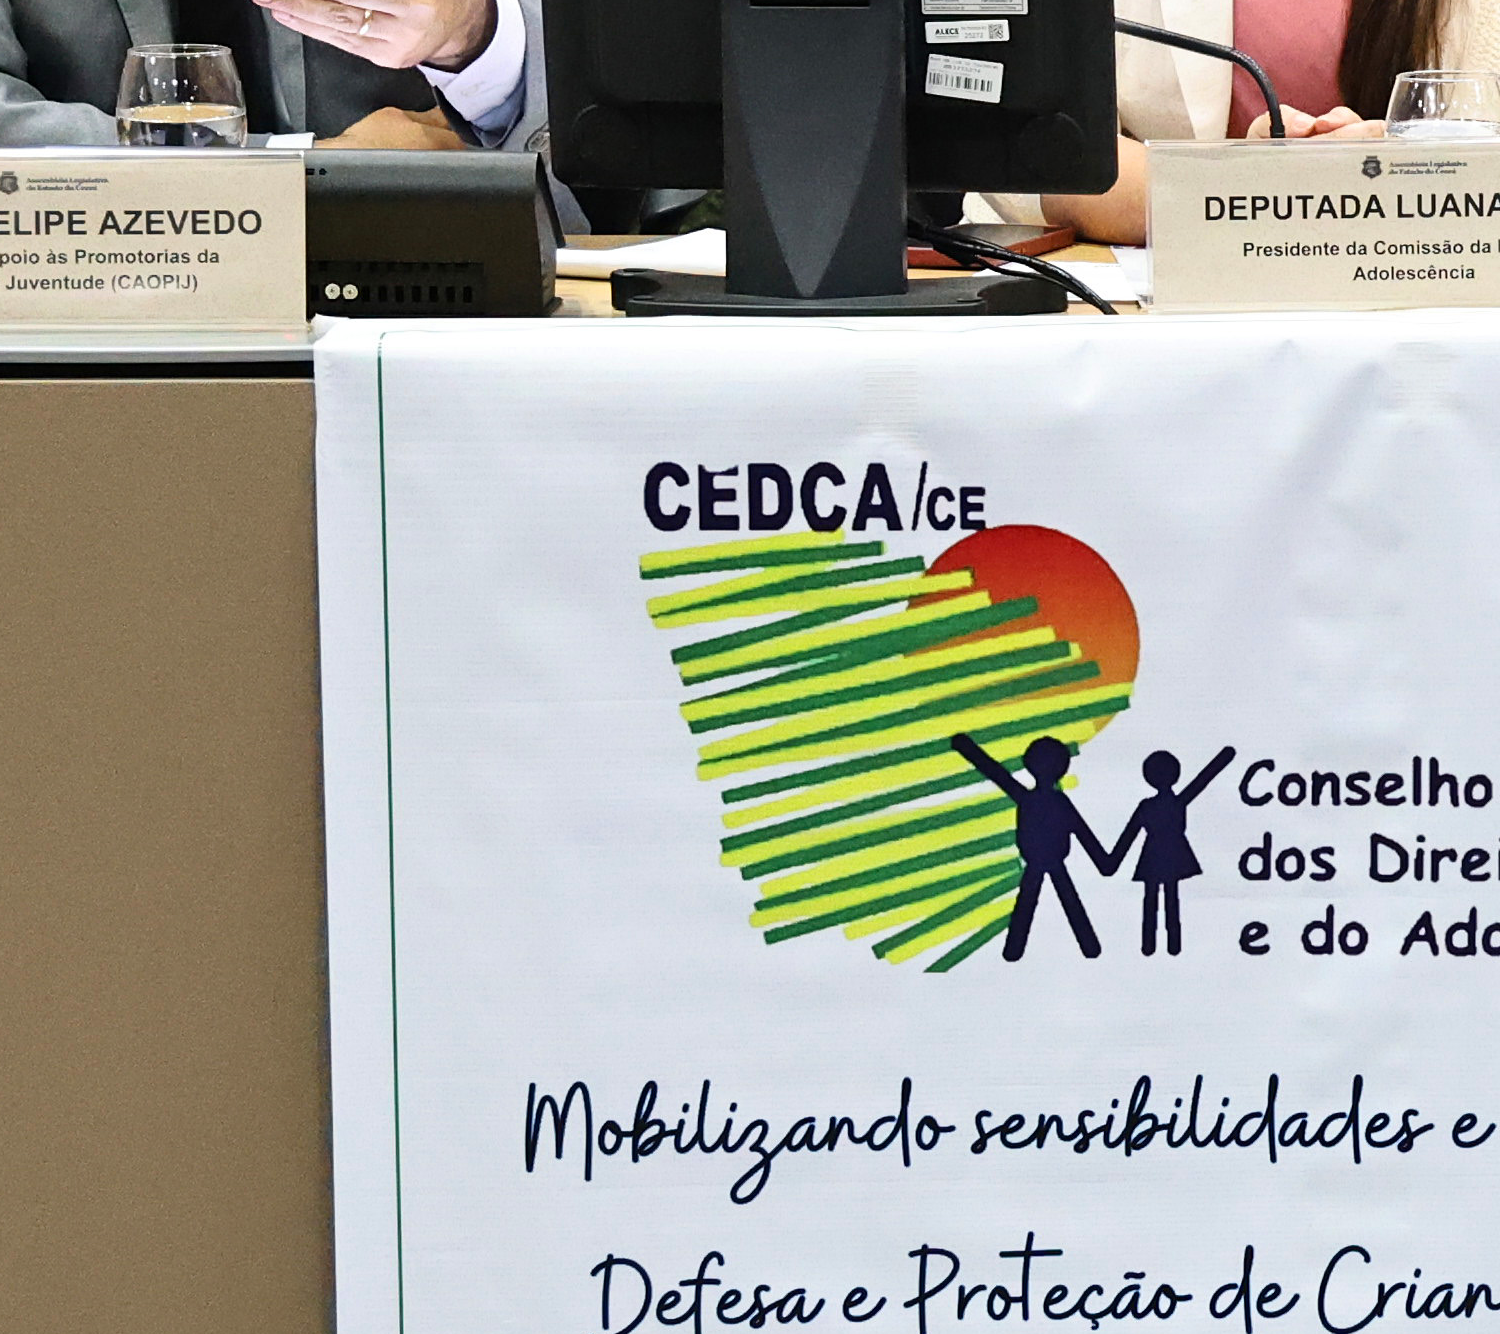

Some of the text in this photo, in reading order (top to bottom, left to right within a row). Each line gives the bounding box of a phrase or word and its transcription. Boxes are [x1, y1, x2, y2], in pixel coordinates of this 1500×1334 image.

[1204, 194, 1386, 221] DEPUTADA
[98, 209, 262, 236] AZEVEDO
[46, 248, 68, 265] às
[74, 248, 191, 265] Promotorias
[197, 248, 220, 264] da
[1243, 241, 1340, 257] Presidente
[1345, 240, 1368, 256] da
[1373, 240, 1464, 256] Comissão
[1470, 239, 1491, 254] da
[5, 274, 105, 291] Juventude
[111, 274, 198, 293] (CAOPIJ)
[1352, 264, 1475, 281] Adolescência
[1238, 755, 1493, 809] Conselho
[1237, 831, 1337, 882] dos
[1238, 920, 1271, 956] e
[1300, 903, 1369, 956] do
[524, 1076, 957, 1205] Mobilizando
[970, 1073, 1435, 1165] sensibilidades
[1451, 1112, 1497, 1149] e
[842, 1286, 888, 1323] e
